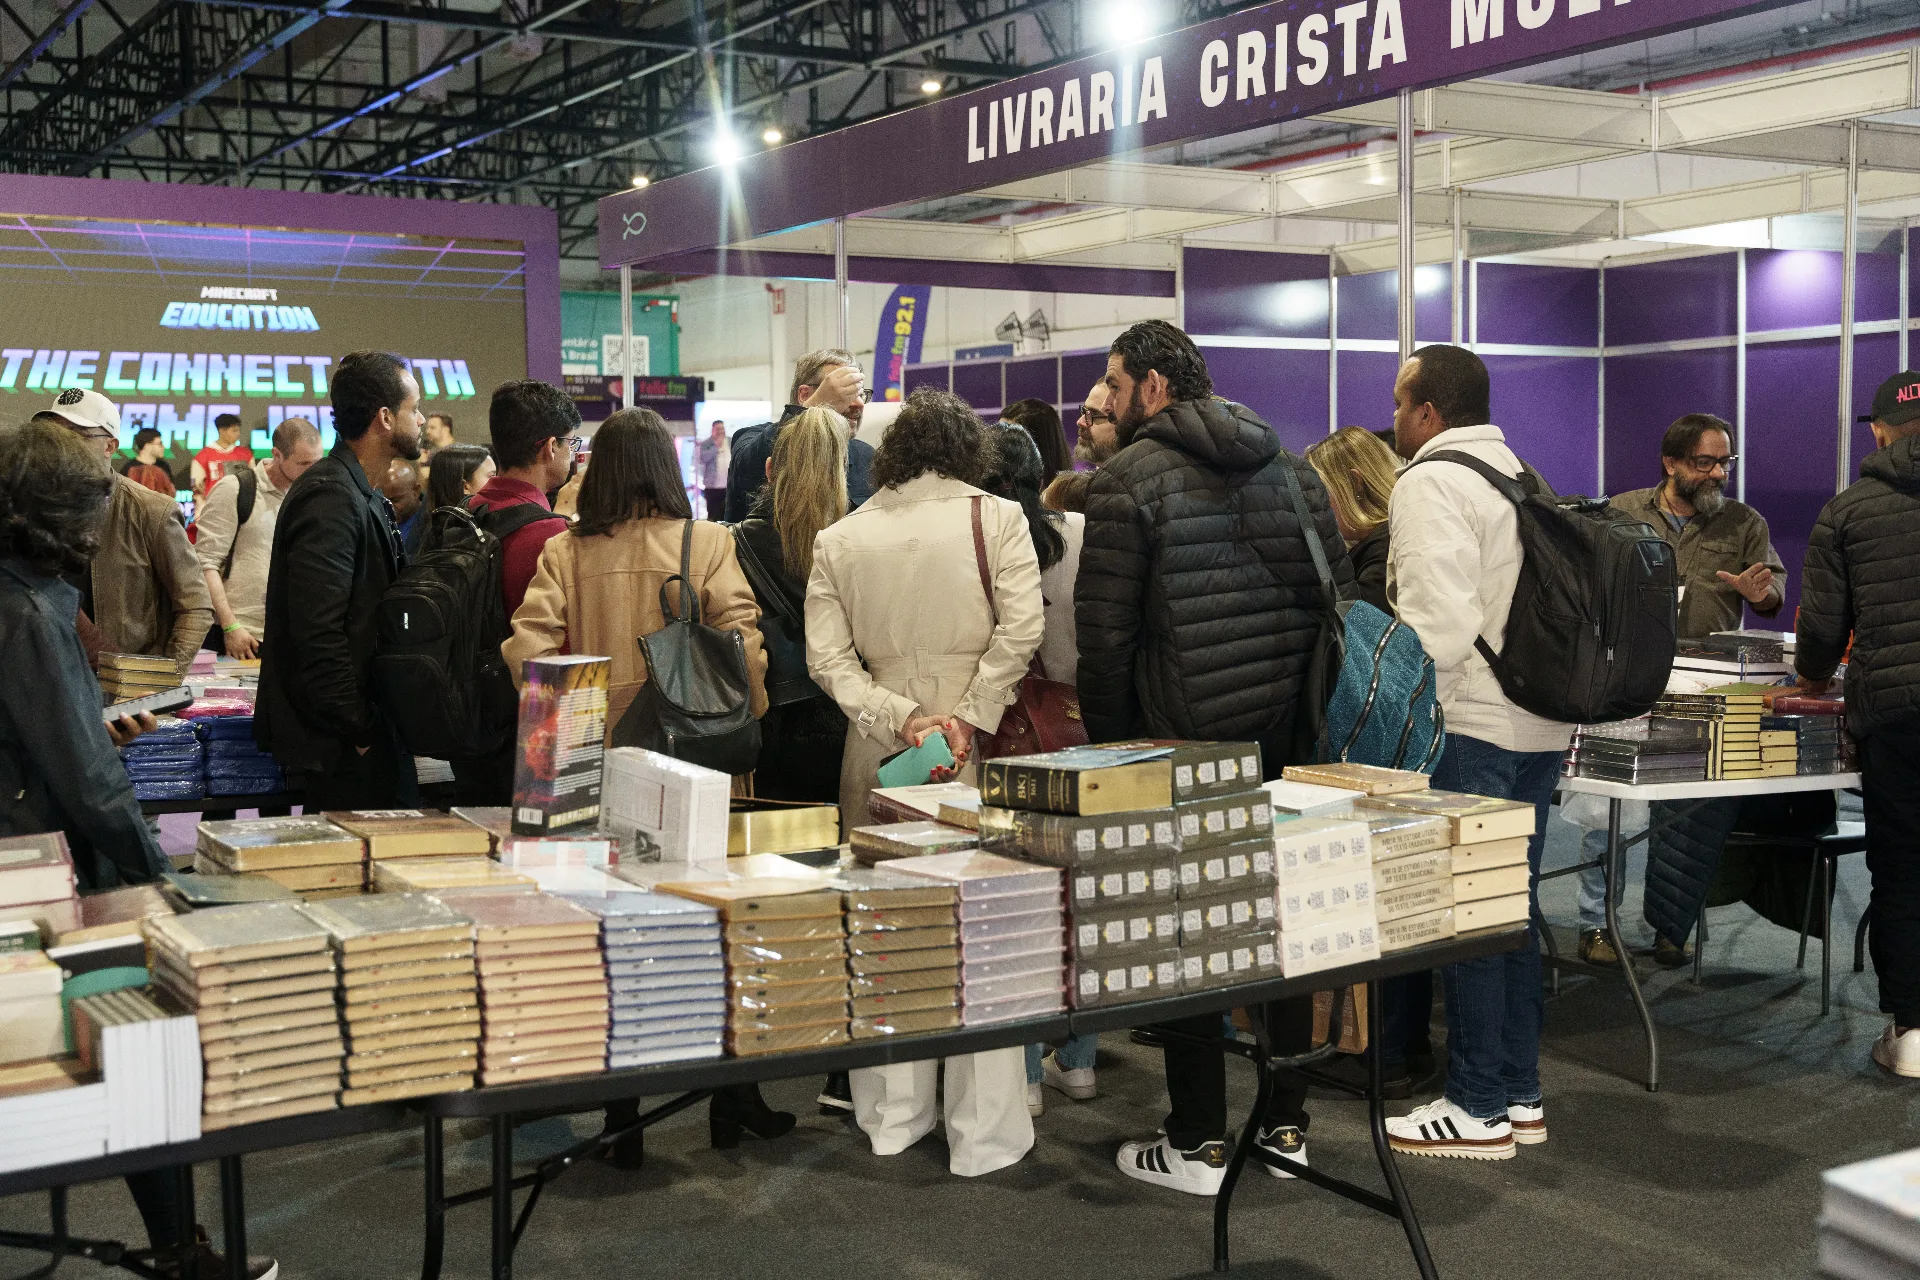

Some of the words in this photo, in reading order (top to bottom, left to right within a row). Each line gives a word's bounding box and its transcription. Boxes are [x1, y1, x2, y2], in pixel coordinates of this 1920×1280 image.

[968, 56, 1167, 163] LIVRARIA
[1200, 0, 1407, 107] CRISTA
[159, 301, 320, 333] EDUCATION
[894, 296, 916, 336] 92.1
[0, 348, 99, 393] THE
[103, 351, 332, 398] CONNECT
[1017, 773, 1027, 799] BKJ
